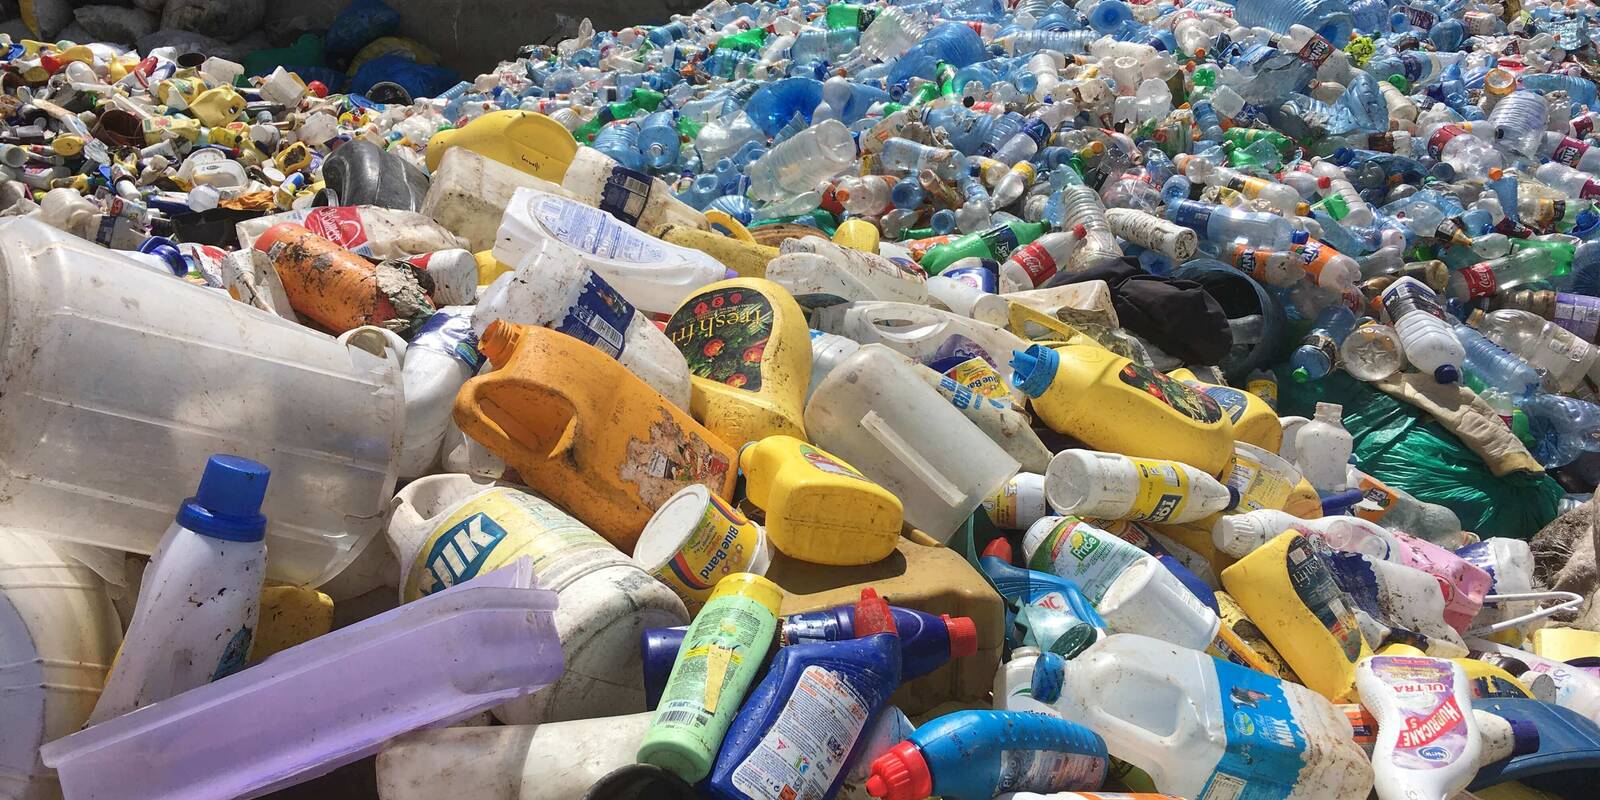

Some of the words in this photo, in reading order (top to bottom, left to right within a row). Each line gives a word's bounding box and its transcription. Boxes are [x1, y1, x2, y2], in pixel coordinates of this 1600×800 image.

[1561, 146, 1578, 167] FANT
[672, 322, 695, 346] fri
[700, 309, 761, 338] fresh
[721, 525, 739, 550] Blue
[1072, 536, 1097, 560] Pride
[432, 515, 497, 588] JIK
[700, 549, 727, 579] Band
[1393, 683, 1446, 693] ULTRA
[1423, 750, 1447, 760] New
